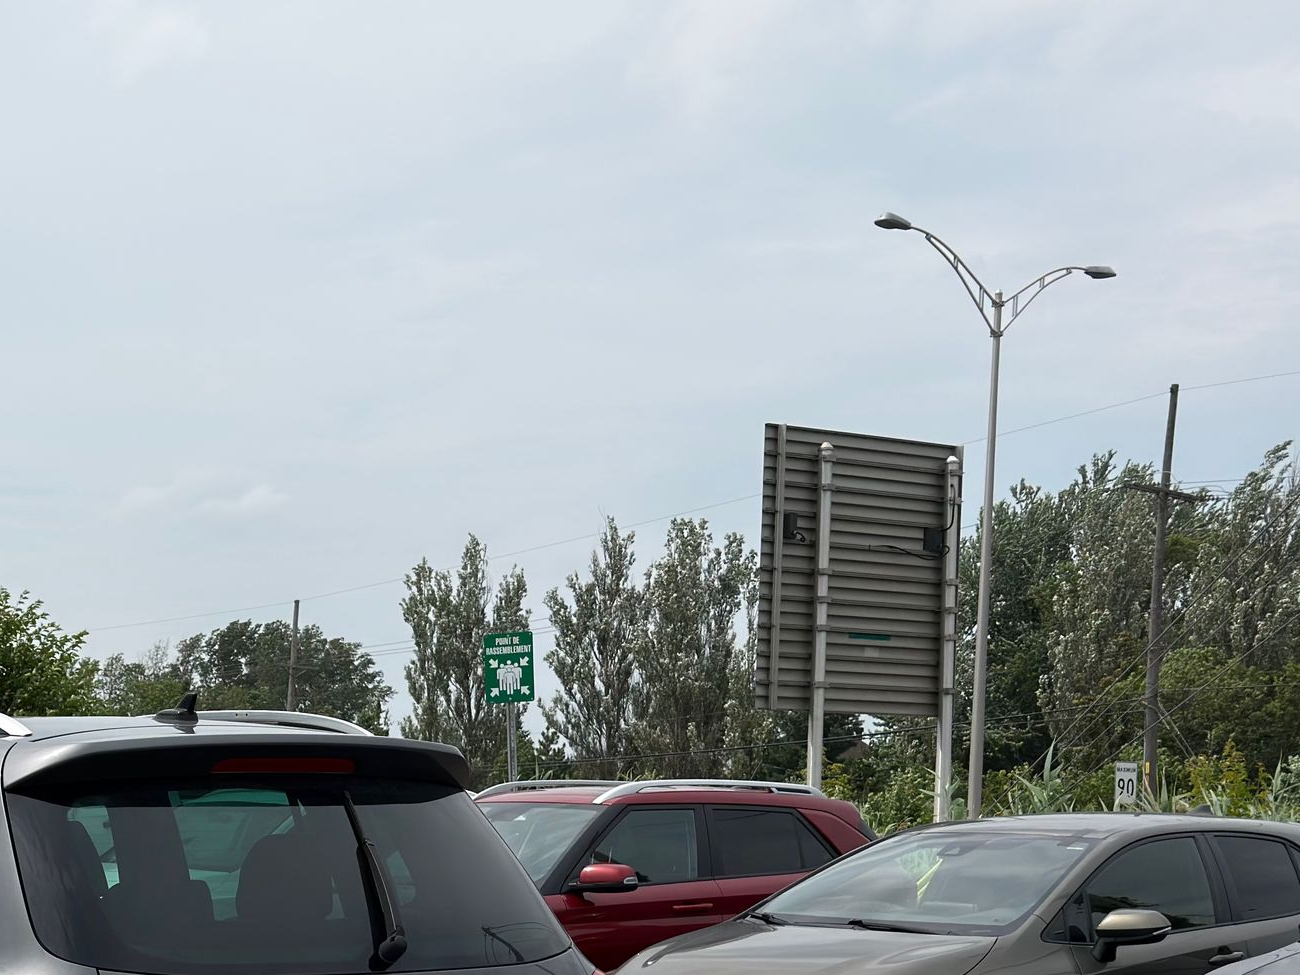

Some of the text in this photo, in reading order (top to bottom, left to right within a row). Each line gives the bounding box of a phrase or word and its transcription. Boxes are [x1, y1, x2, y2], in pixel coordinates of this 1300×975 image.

[495, 636, 520, 646] POINT DE
[485, 645, 531, 656] RASSEMBLEMENT
[1117, 778, 1134, 798] 90
